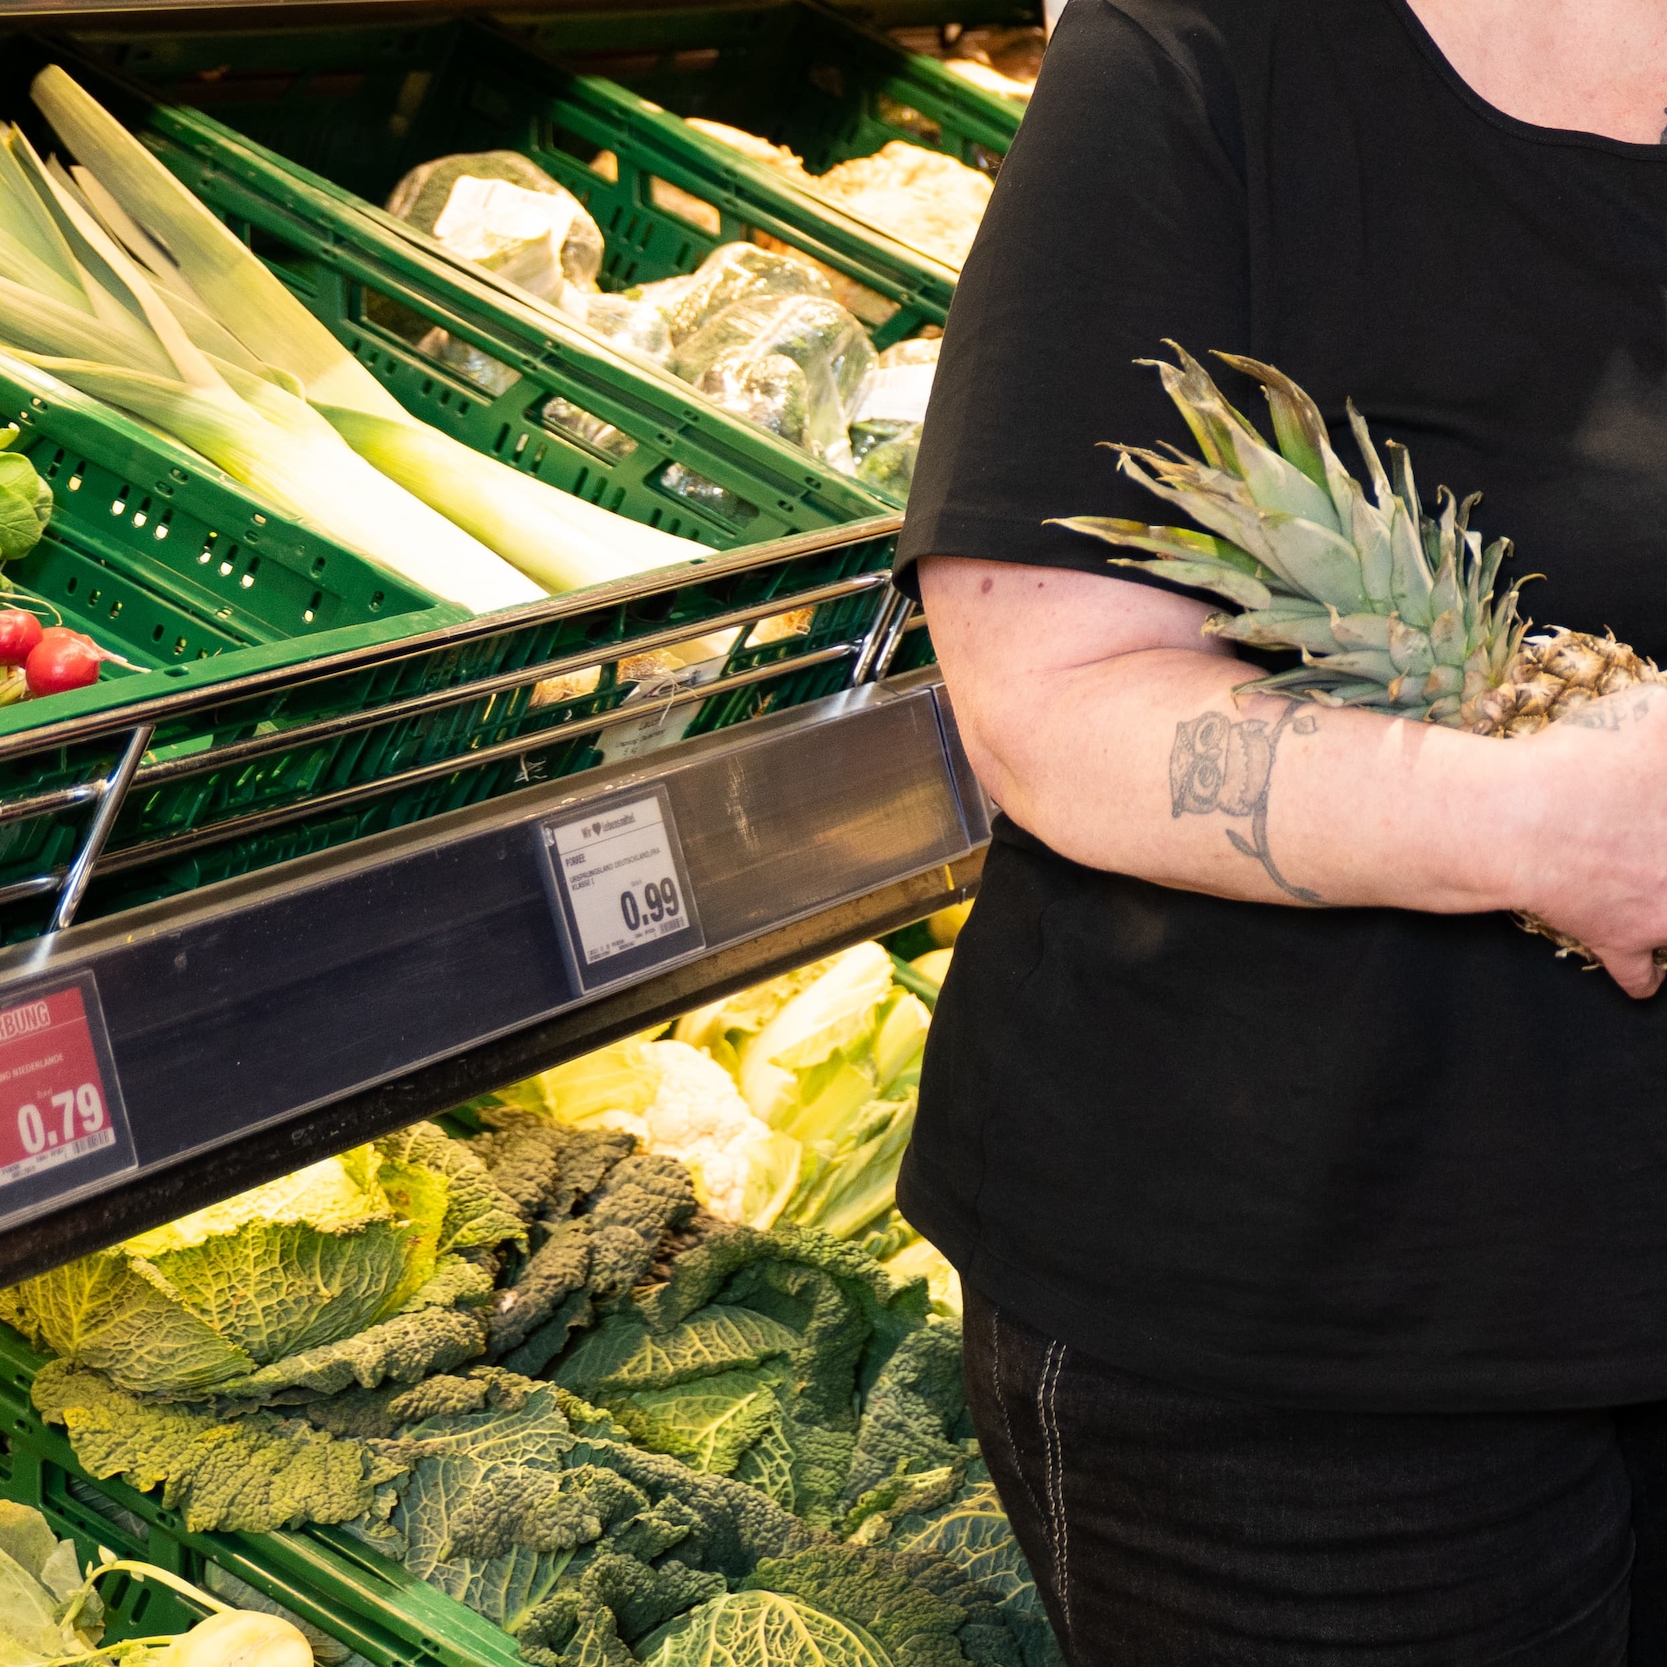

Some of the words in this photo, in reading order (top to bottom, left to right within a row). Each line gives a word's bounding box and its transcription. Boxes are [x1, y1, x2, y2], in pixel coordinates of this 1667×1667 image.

[620, 877, 680, 931] 0.99
[12, 1052, 65, 1077] NIEDERLANDE
[17, 1083, 104, 1154] 0.79
